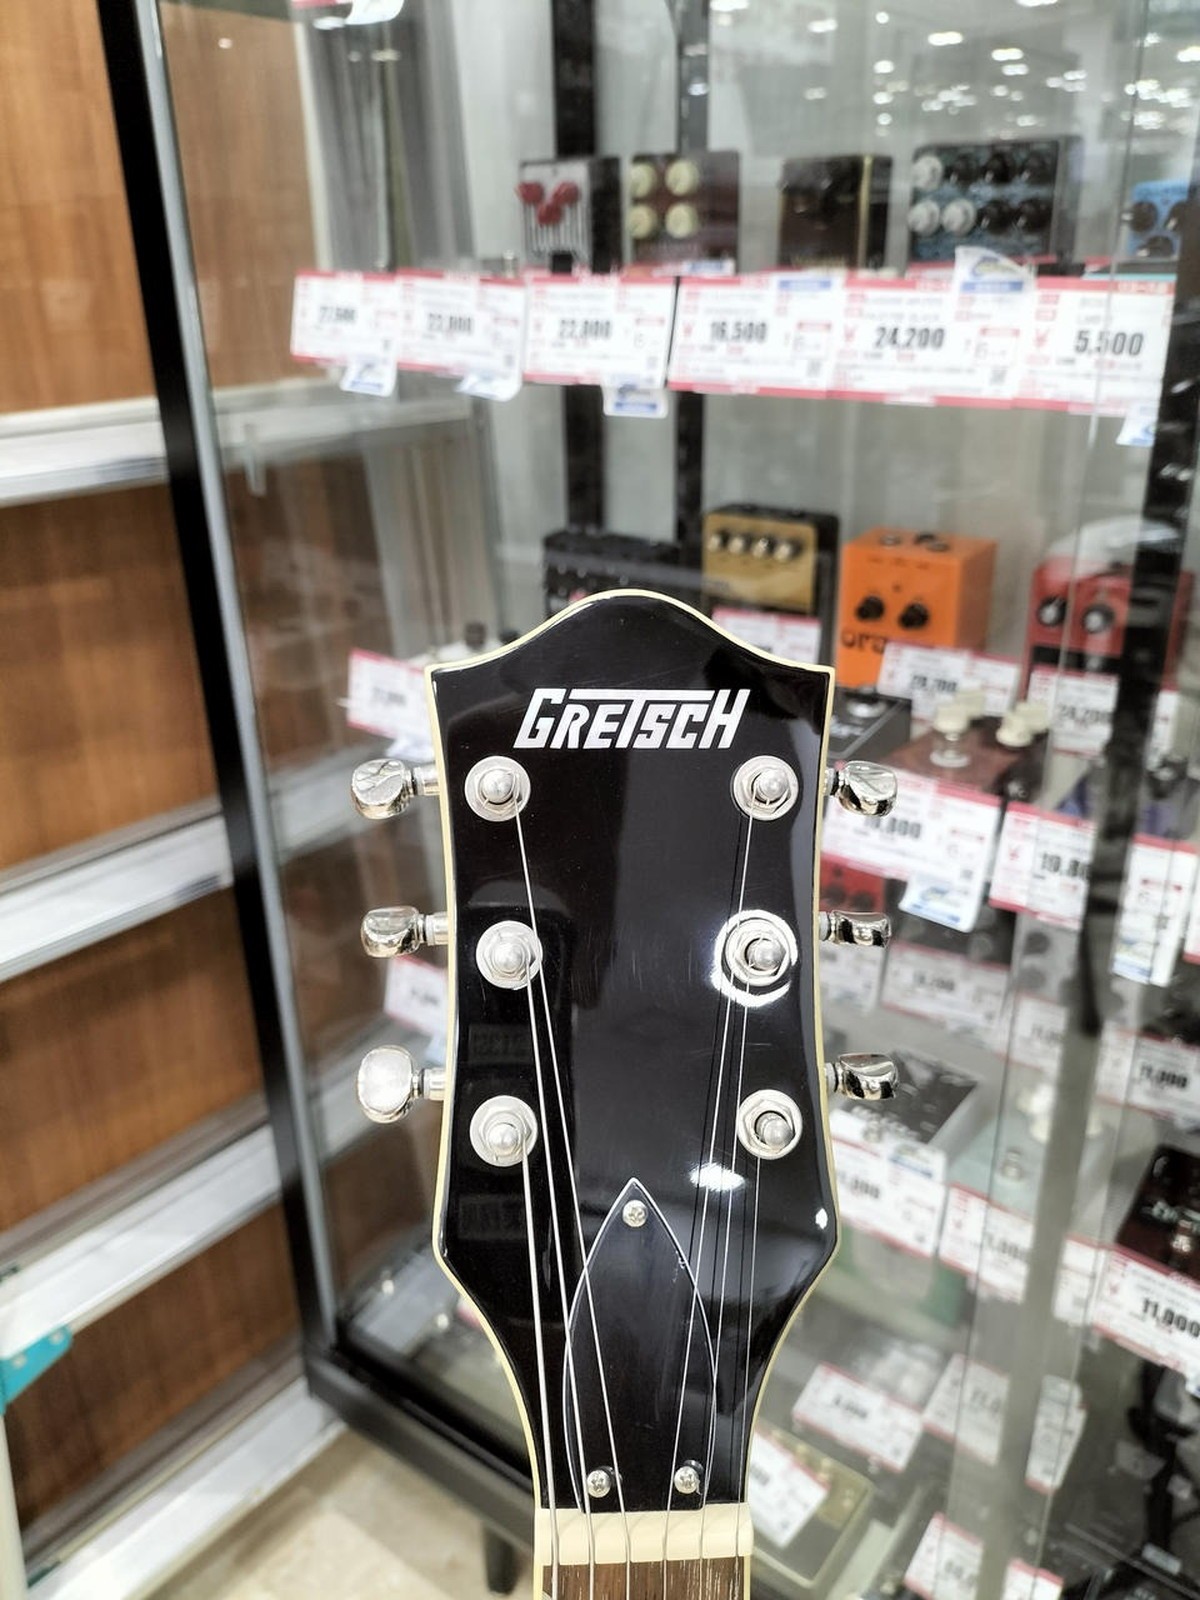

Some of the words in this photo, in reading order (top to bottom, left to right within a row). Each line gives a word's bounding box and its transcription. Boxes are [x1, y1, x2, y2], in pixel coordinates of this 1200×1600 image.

[875, 325, 945, 349] 24,200
[1074, 329, 1145, 357] 5,500
[1143, 1298, 1200, 1338] 11,000
